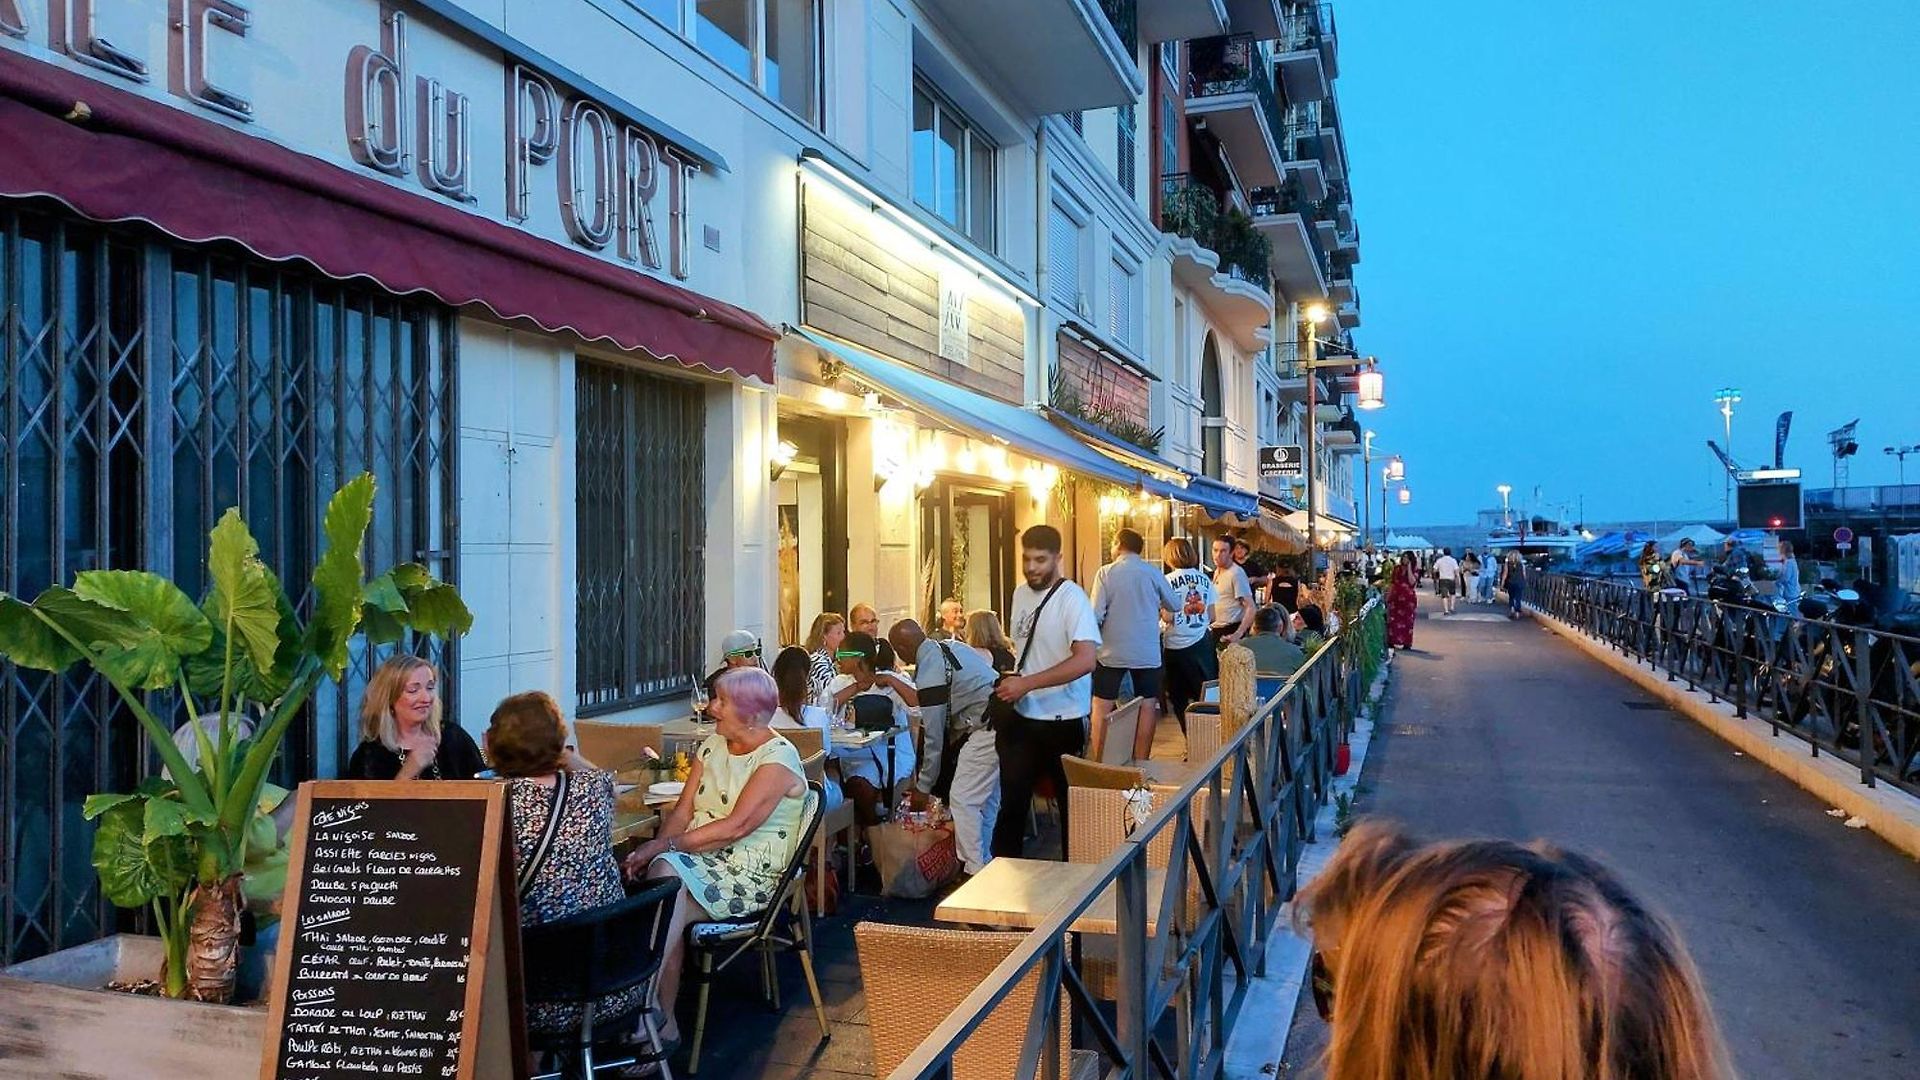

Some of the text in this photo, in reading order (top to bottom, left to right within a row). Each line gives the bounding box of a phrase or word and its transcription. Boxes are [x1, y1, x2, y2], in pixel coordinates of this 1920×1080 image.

[344, 5, 478, 205] du
[504, 62, 700, 281] PORT
[1170, 574, 1210, 590] NARUTO
[315, 831, 328, 840] LA
[309, 894, 355, 904] GNOCCHI
[301, 953, 340, 964] CÉSAR
